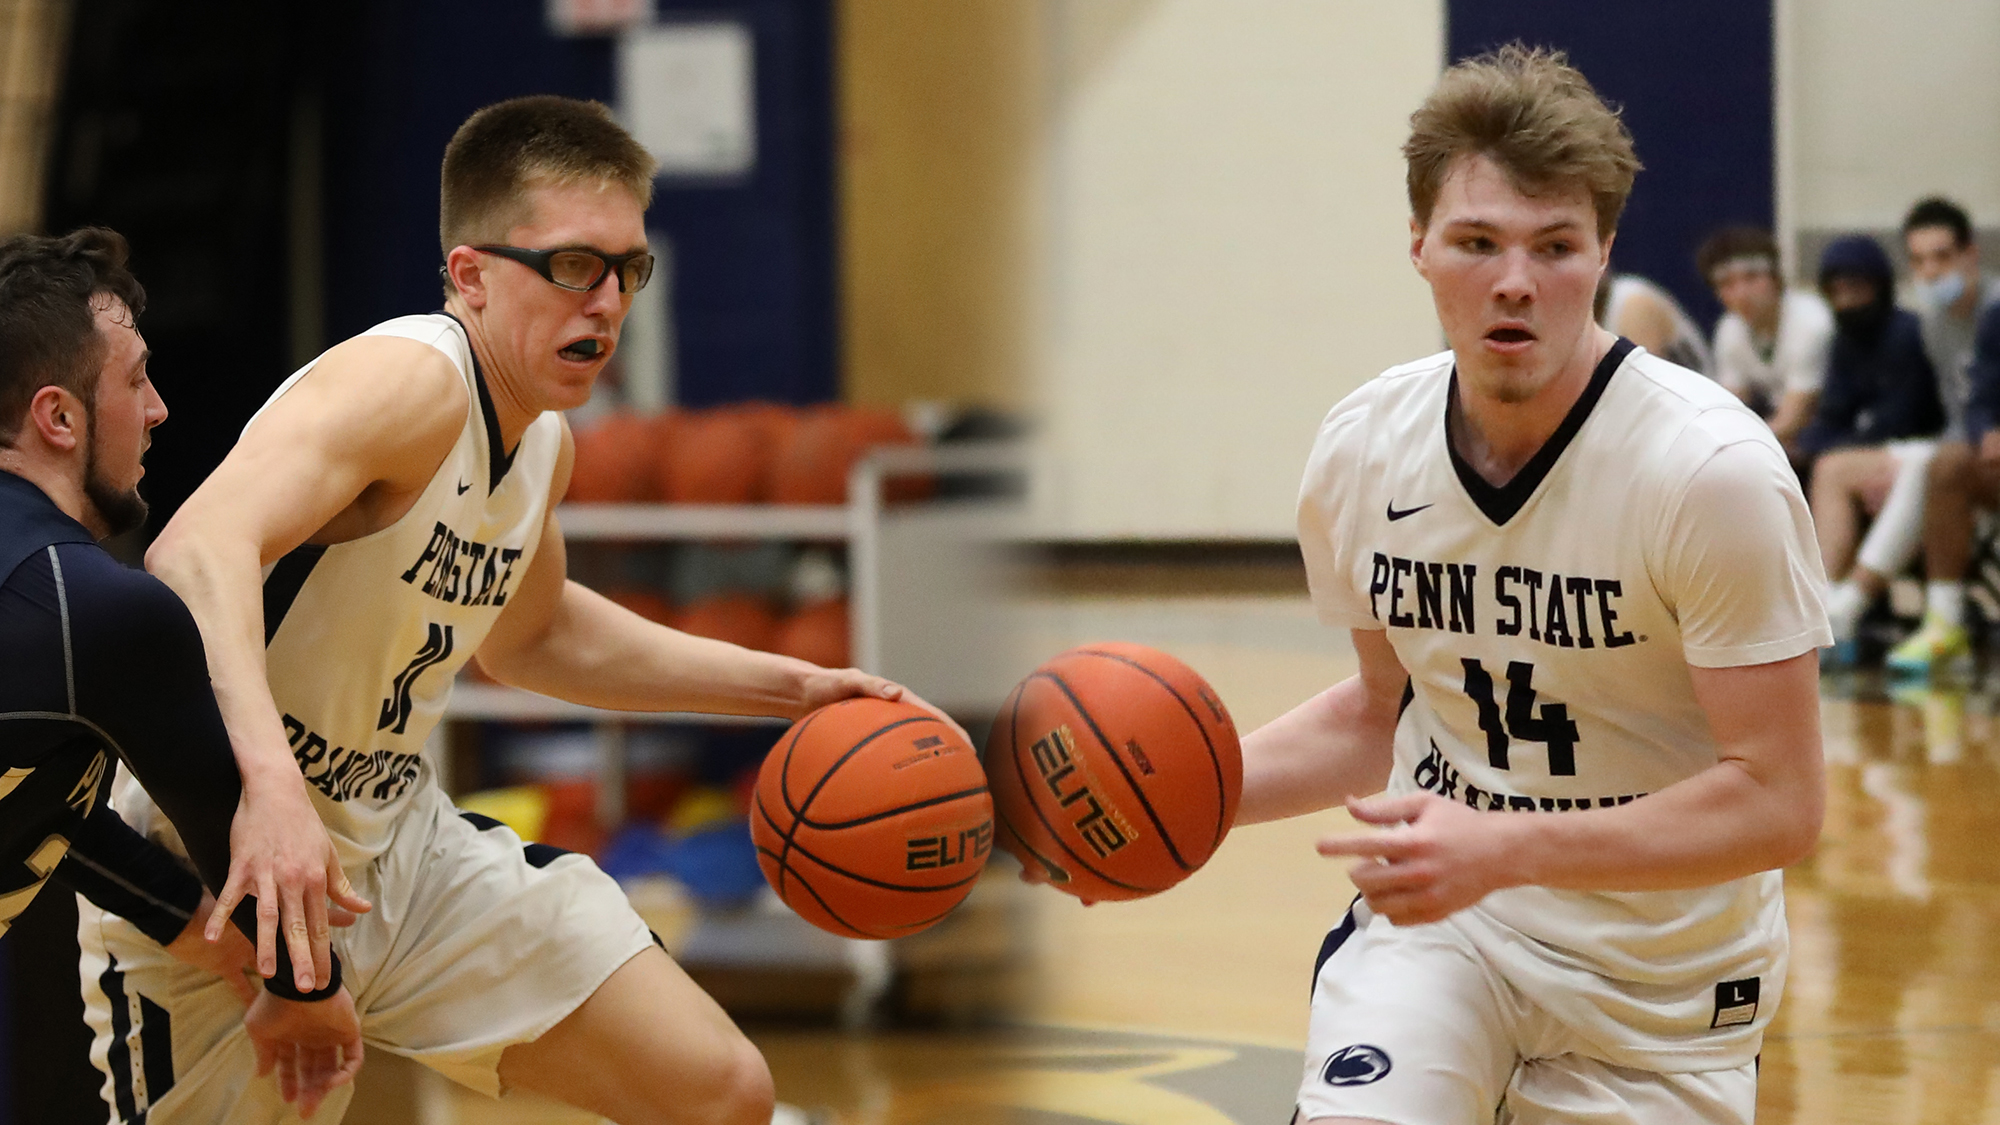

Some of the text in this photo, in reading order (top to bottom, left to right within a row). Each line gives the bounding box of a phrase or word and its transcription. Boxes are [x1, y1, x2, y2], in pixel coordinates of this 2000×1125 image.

[400, 521, 524, 607] PEN STATE
[1369, 552, 1636, 649] PENN STATE
[1460, 657, 1581, 776] 14
[1029, 728, 1128, 859] ELITE
[906, 819, 993, 872] ELITE
[1734, 986, 1745, 1001] L
